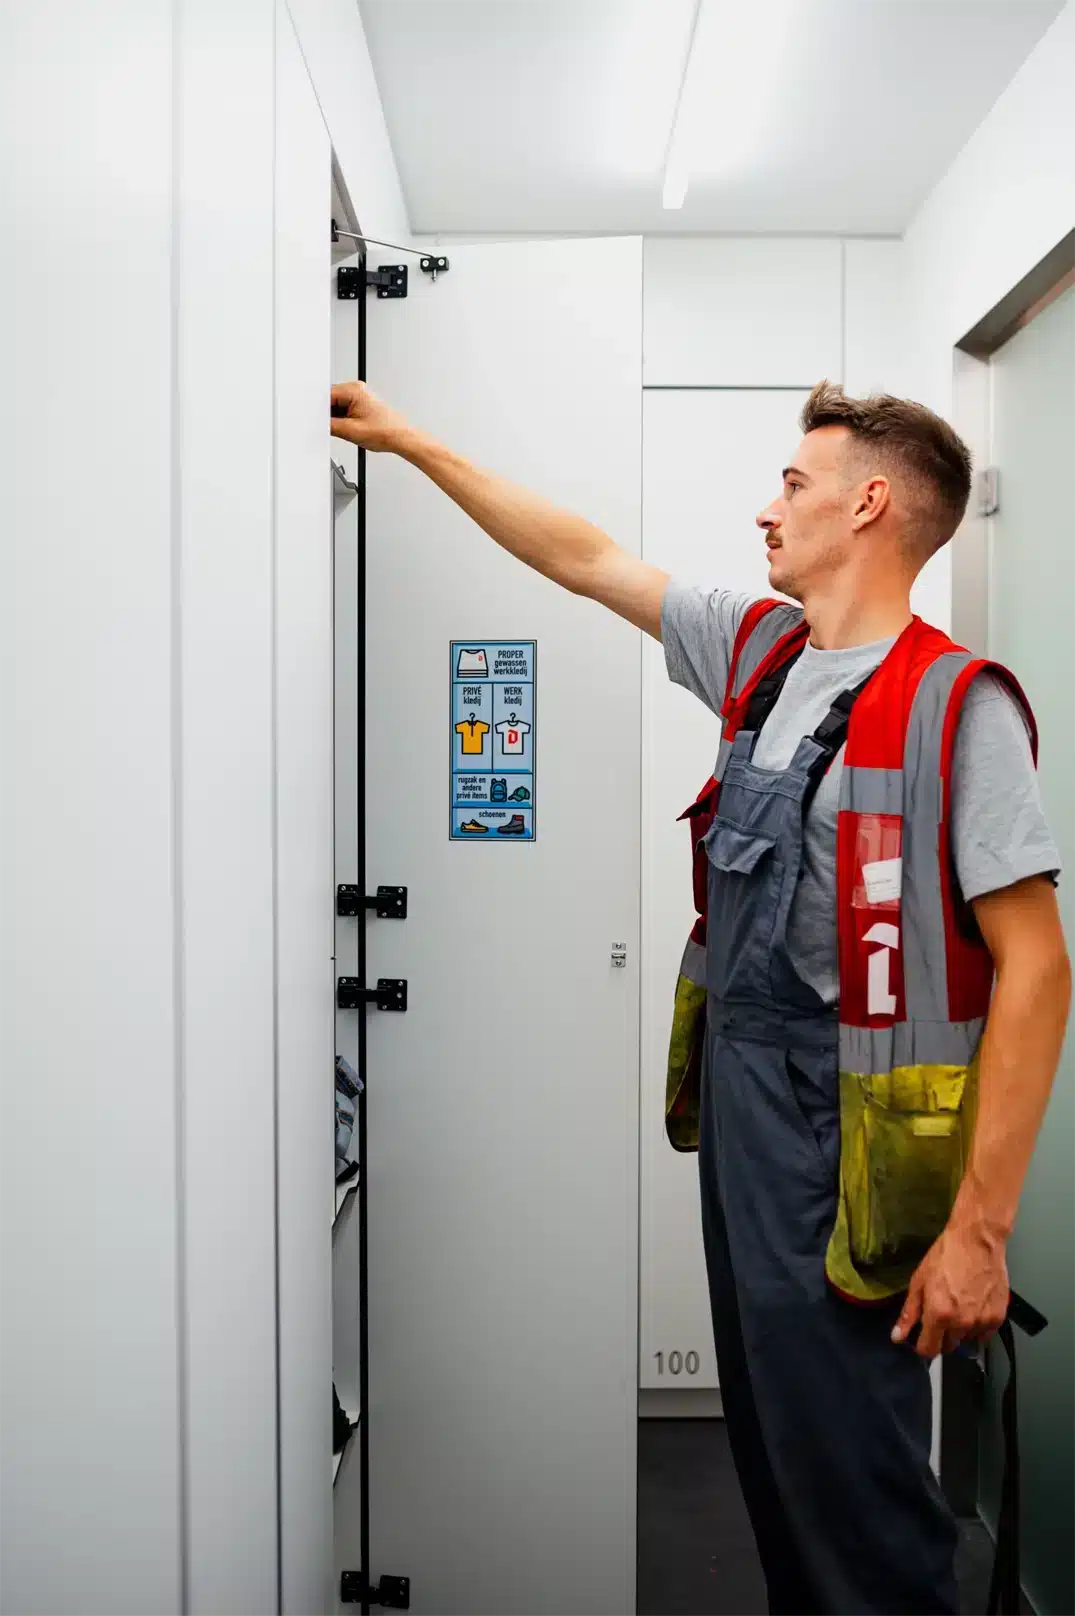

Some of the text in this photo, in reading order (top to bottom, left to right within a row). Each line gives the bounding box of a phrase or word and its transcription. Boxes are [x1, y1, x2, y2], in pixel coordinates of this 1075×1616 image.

[498, 650, 523, 658] PROPER
[495, 660, 526, 668] gewassen
[494, 667, 527, 676] werkkledij
[463, 686, 482, 695] PRIVÉ
[504, 687, 522, 695] WERK
[463, 697, 481, 706] kledij
[504, 697, 522, 706] kledij
[458, 776, 477, 784] rugzak
[479, 810, 506, 818] schoenen
[653, 1350, 700, 1375] 100
